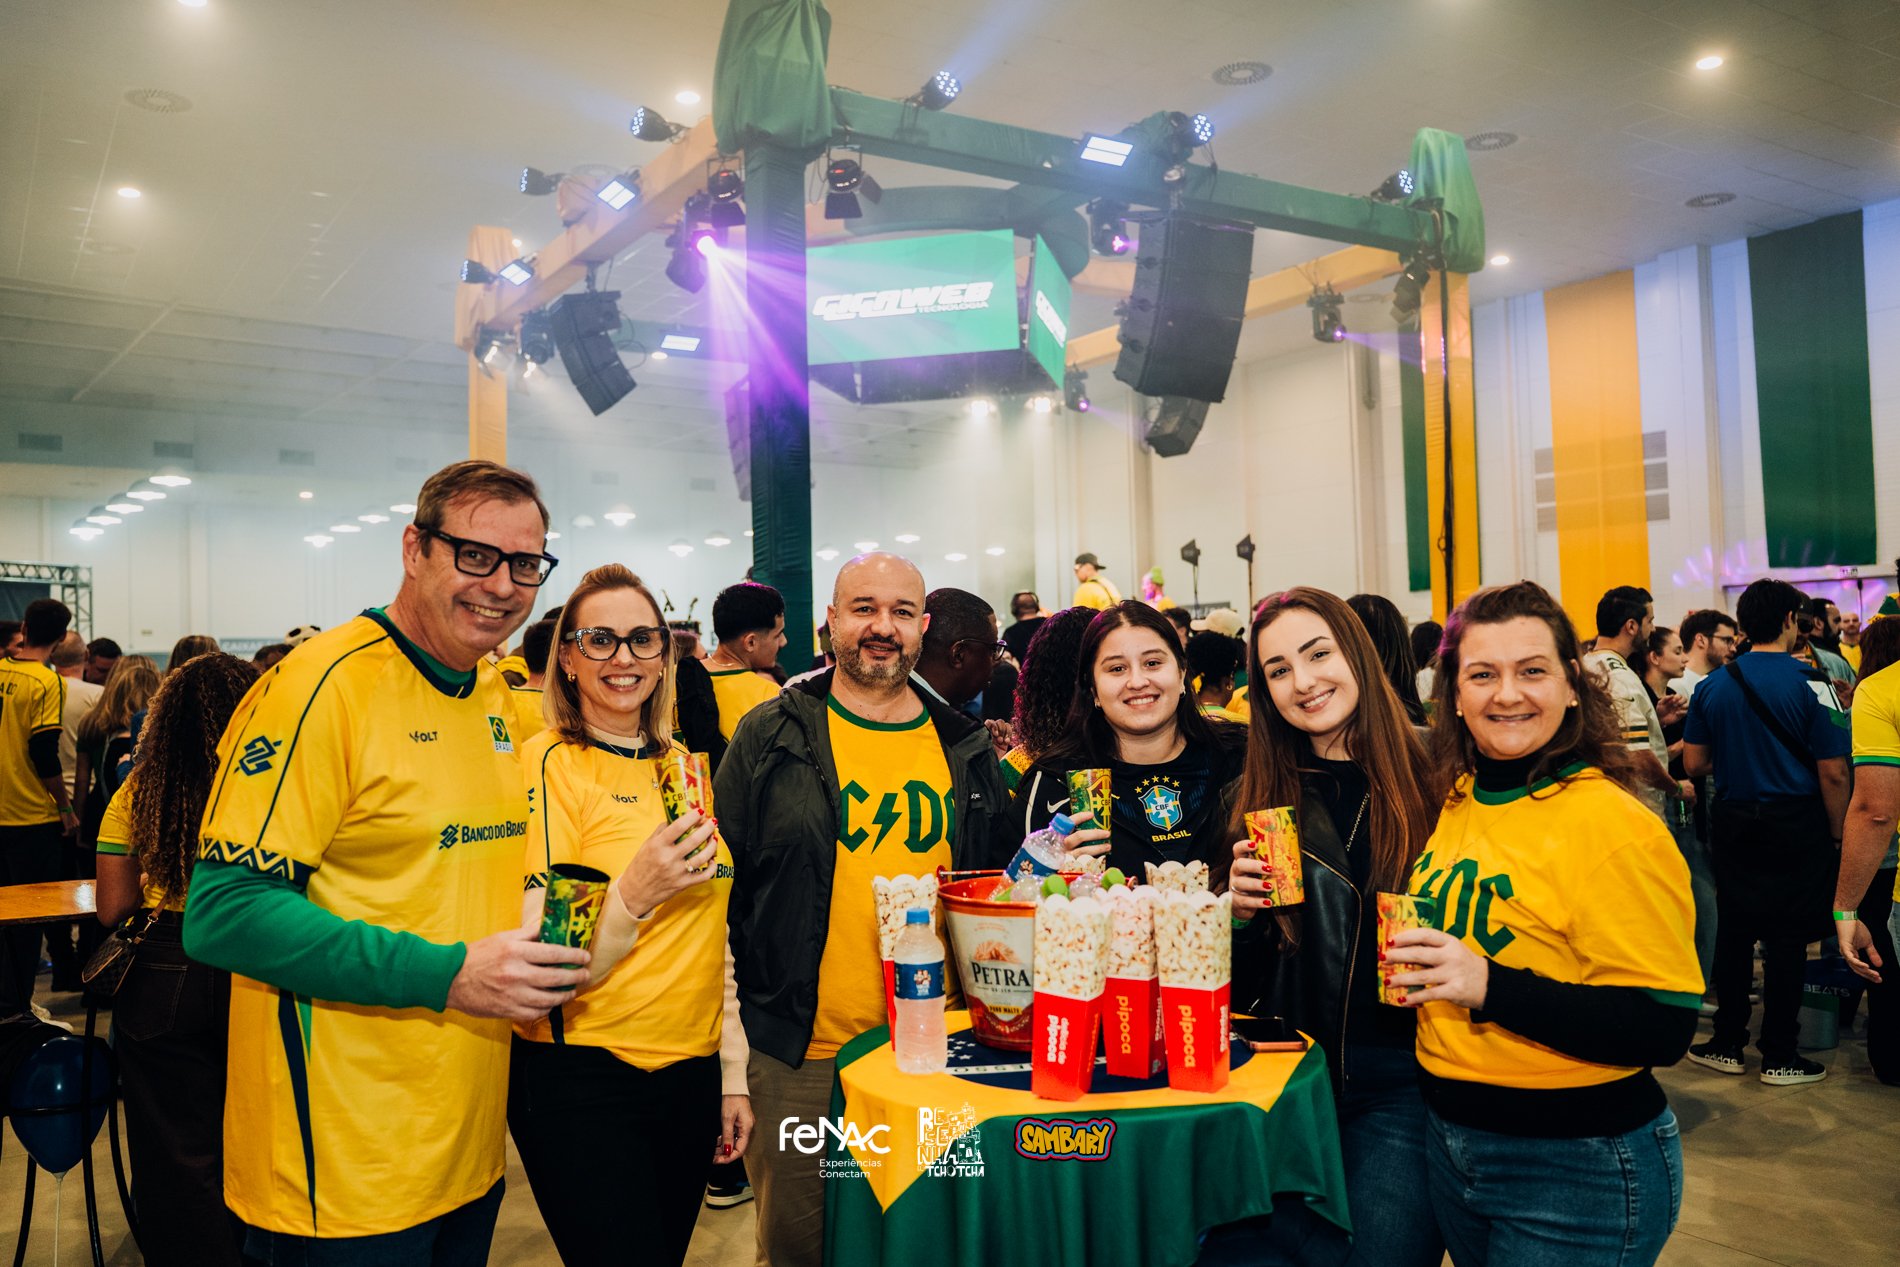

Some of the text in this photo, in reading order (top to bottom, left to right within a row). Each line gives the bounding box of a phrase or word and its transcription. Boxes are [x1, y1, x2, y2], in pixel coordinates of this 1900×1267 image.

[409, 731, 438, 743] VOLT
[612, 794, 638, 803] VOLT
[1155, 803, 1170, 811] CBF
[461, 825, 494, 844] BANCO
[495, 823, 506, 839] DO
[1151, 829, 1191, 842] BRASIL
[970, 961, 1031, 987] PETRA
[1116, 995, 1132, 1054] pipoca
[1178, 1005, 1197, 1067] pipoca
[1704, 1053, 1738, 1066] adidas
[1766, 1067, 1805, 1077] adidas
